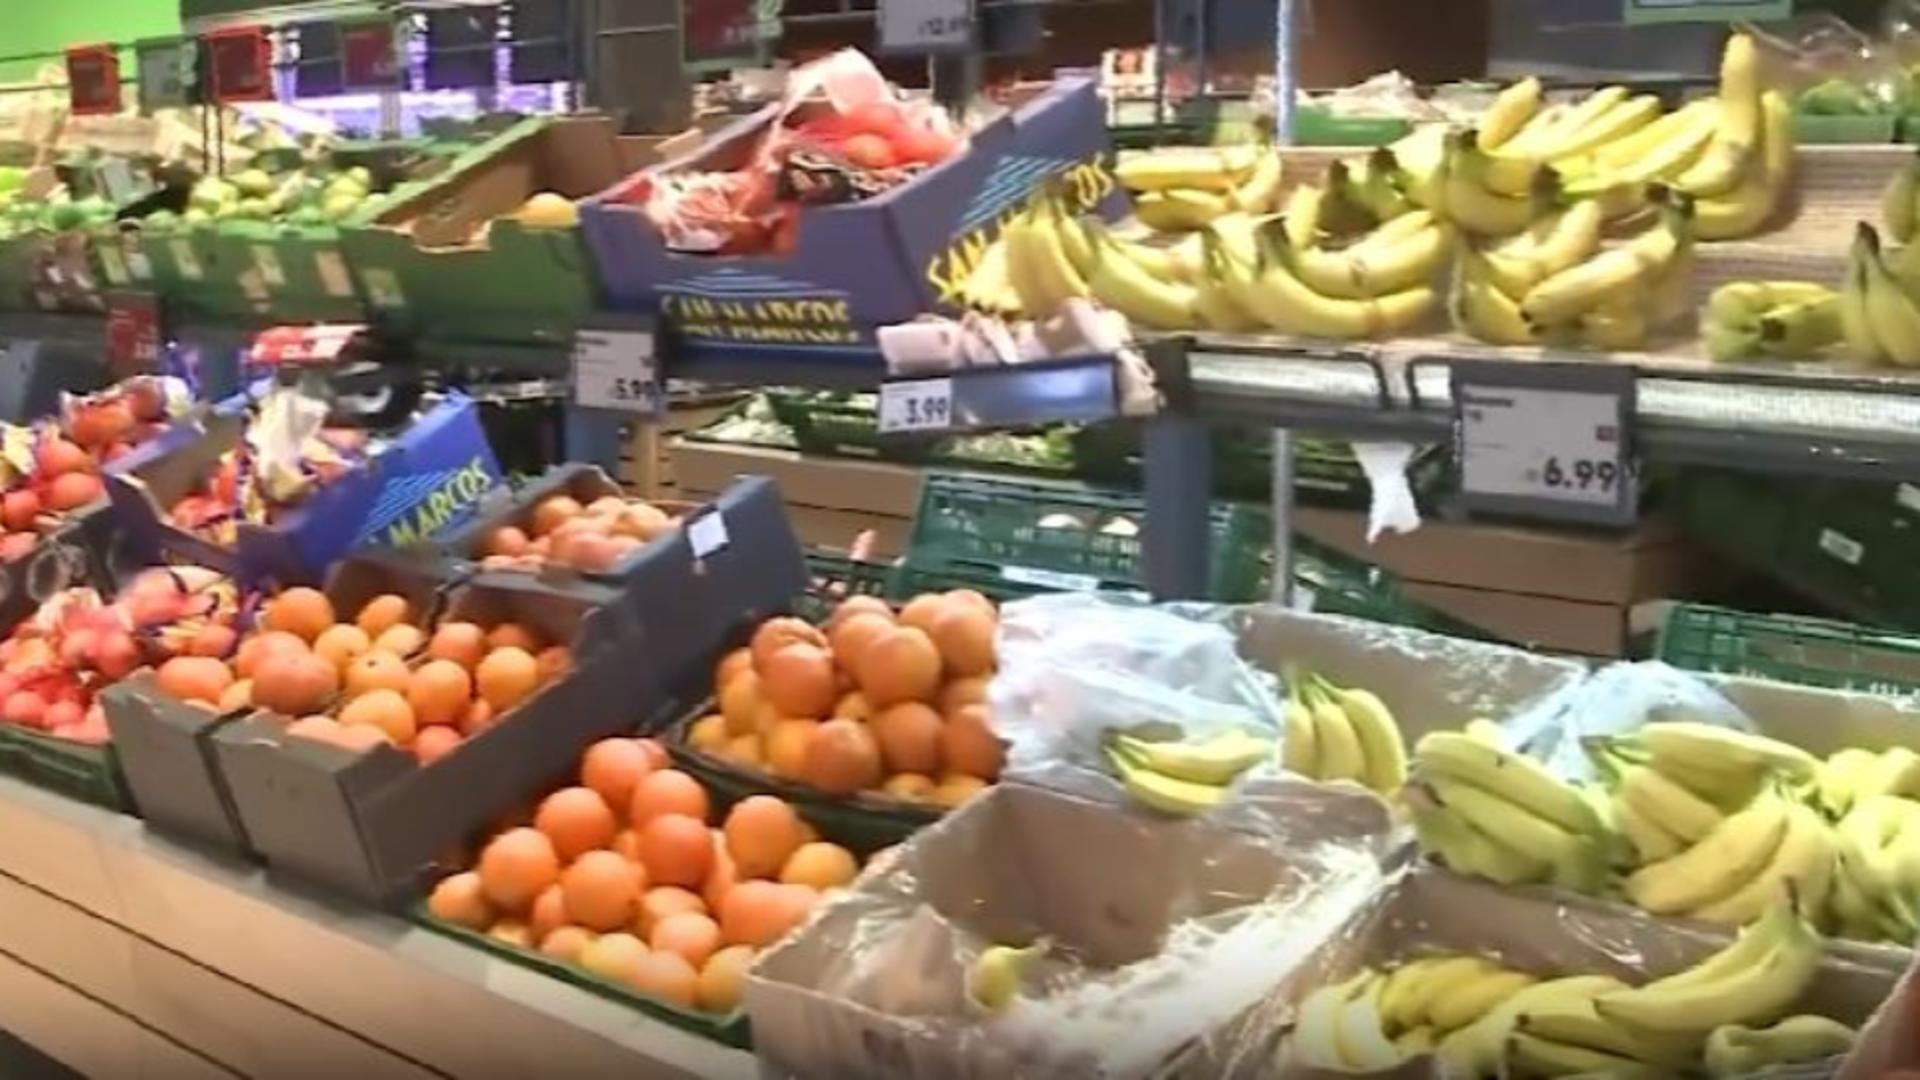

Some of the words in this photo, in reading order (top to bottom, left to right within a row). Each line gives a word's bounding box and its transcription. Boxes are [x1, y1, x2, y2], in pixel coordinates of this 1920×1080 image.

[906, 396, 948, 424] 3.99
[1544, 457, 1616, 493] 6.99
[389, 456, 491, 548] MARCOS
